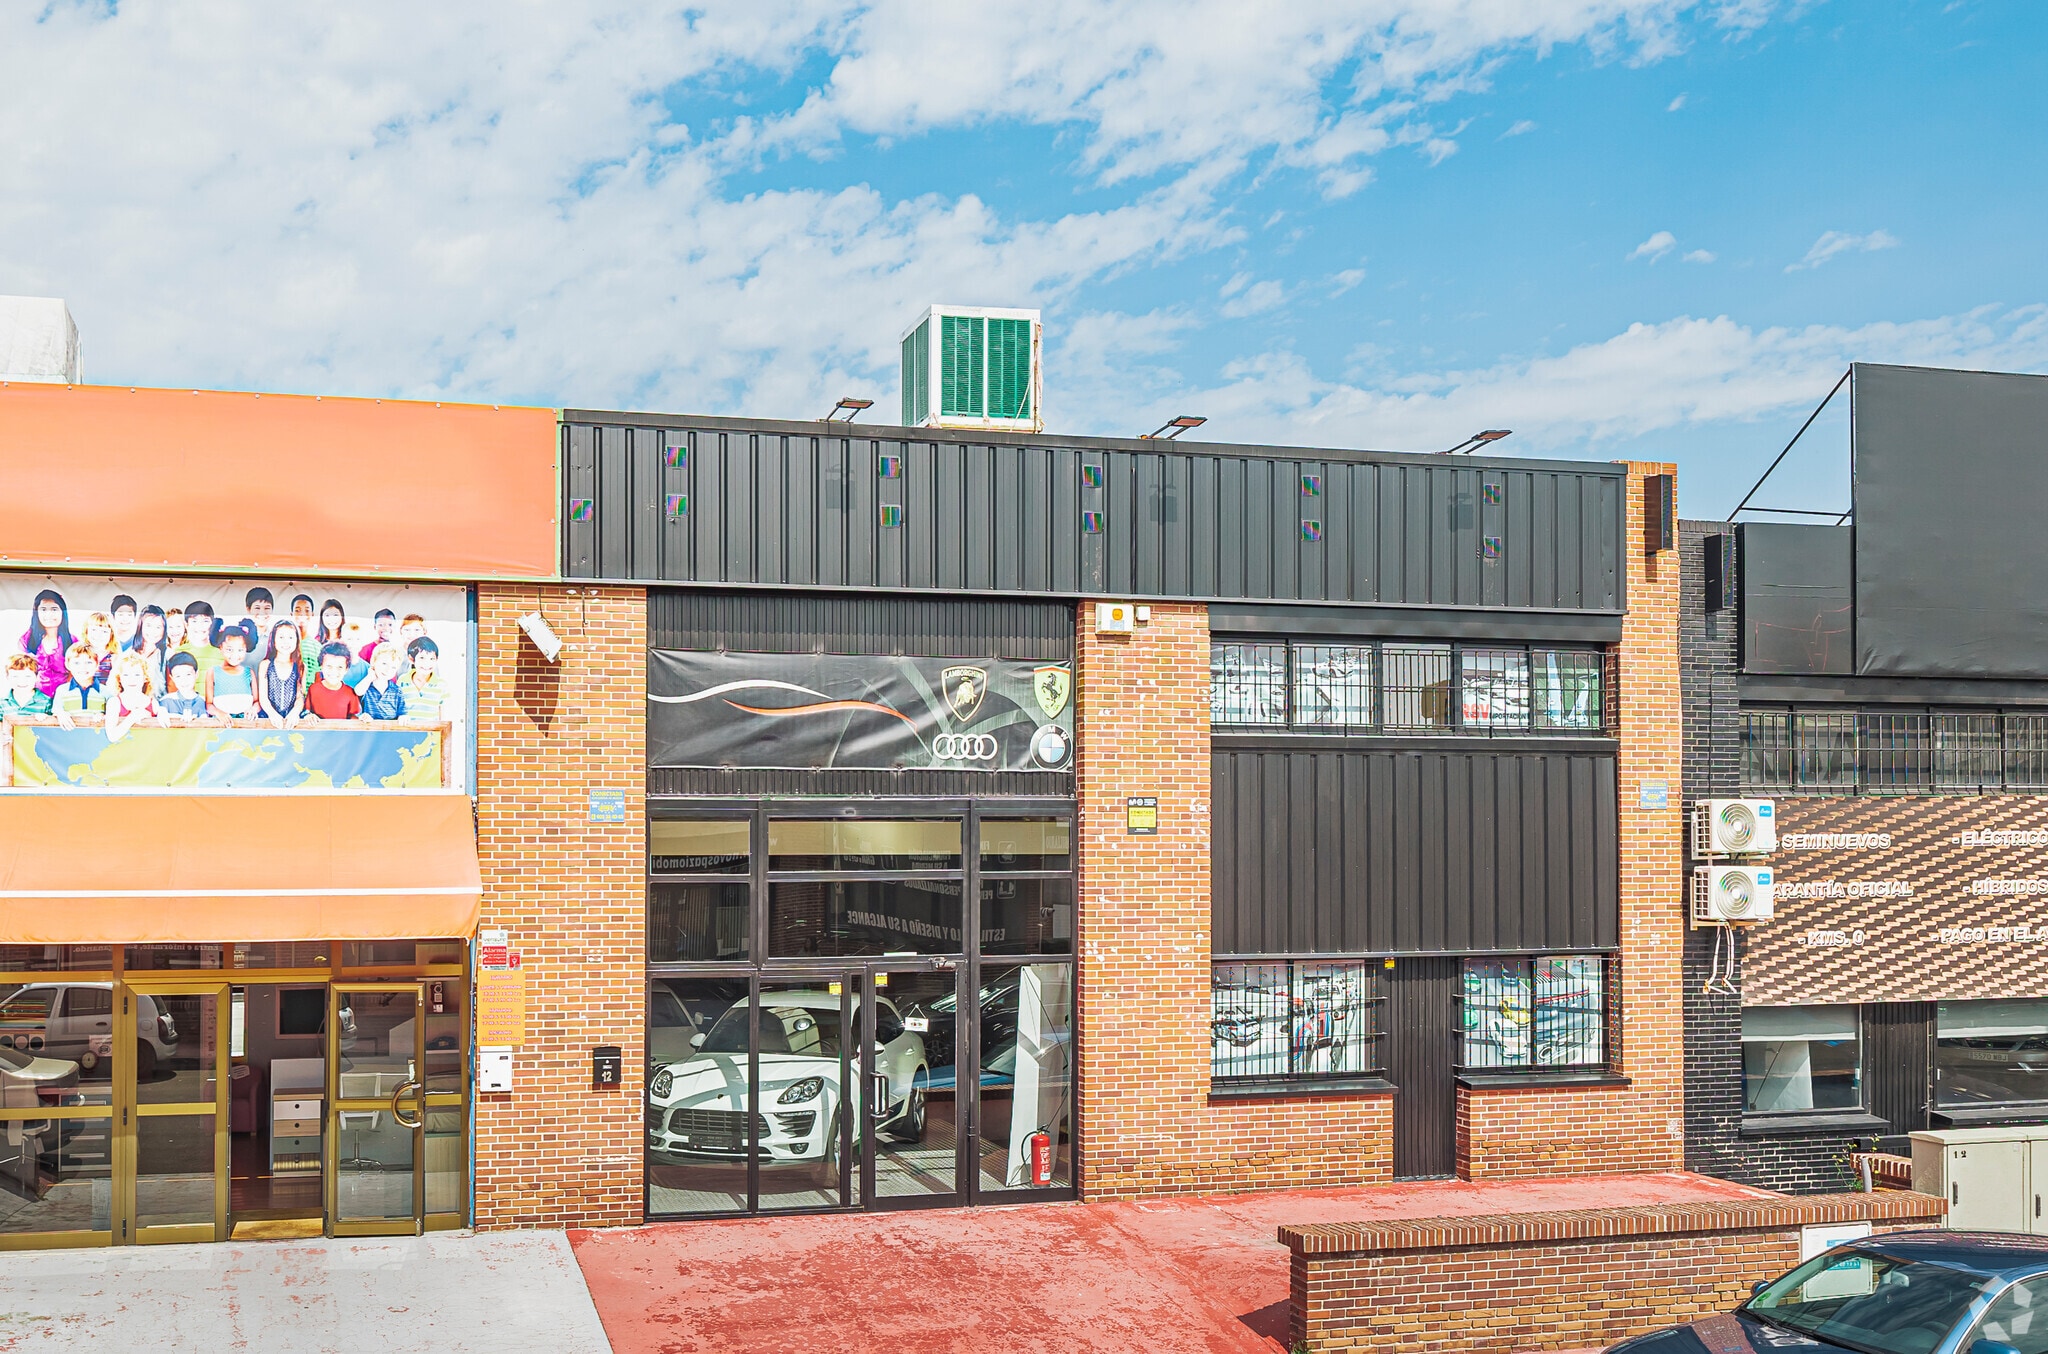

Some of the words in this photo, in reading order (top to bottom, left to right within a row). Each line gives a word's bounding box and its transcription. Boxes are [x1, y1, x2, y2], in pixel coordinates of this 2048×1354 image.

[1781, 833, 1891, 849] SEMINUEVOS
[1962, 828, 2048, 846] ELÉCTRICO
[1773, 880, 1846, 898] ARANTÍA
[1847, 881, 1914, 897] OFICIAL
[1972, 877, 2048, 895] HÍBRIDOS
[1940, 927, 1985, 943] PAGO
[1987, 926, 2010, 942] EN
[2013, 925, 2033, 942] EL
[601, 1071, 612, 1082] 12
